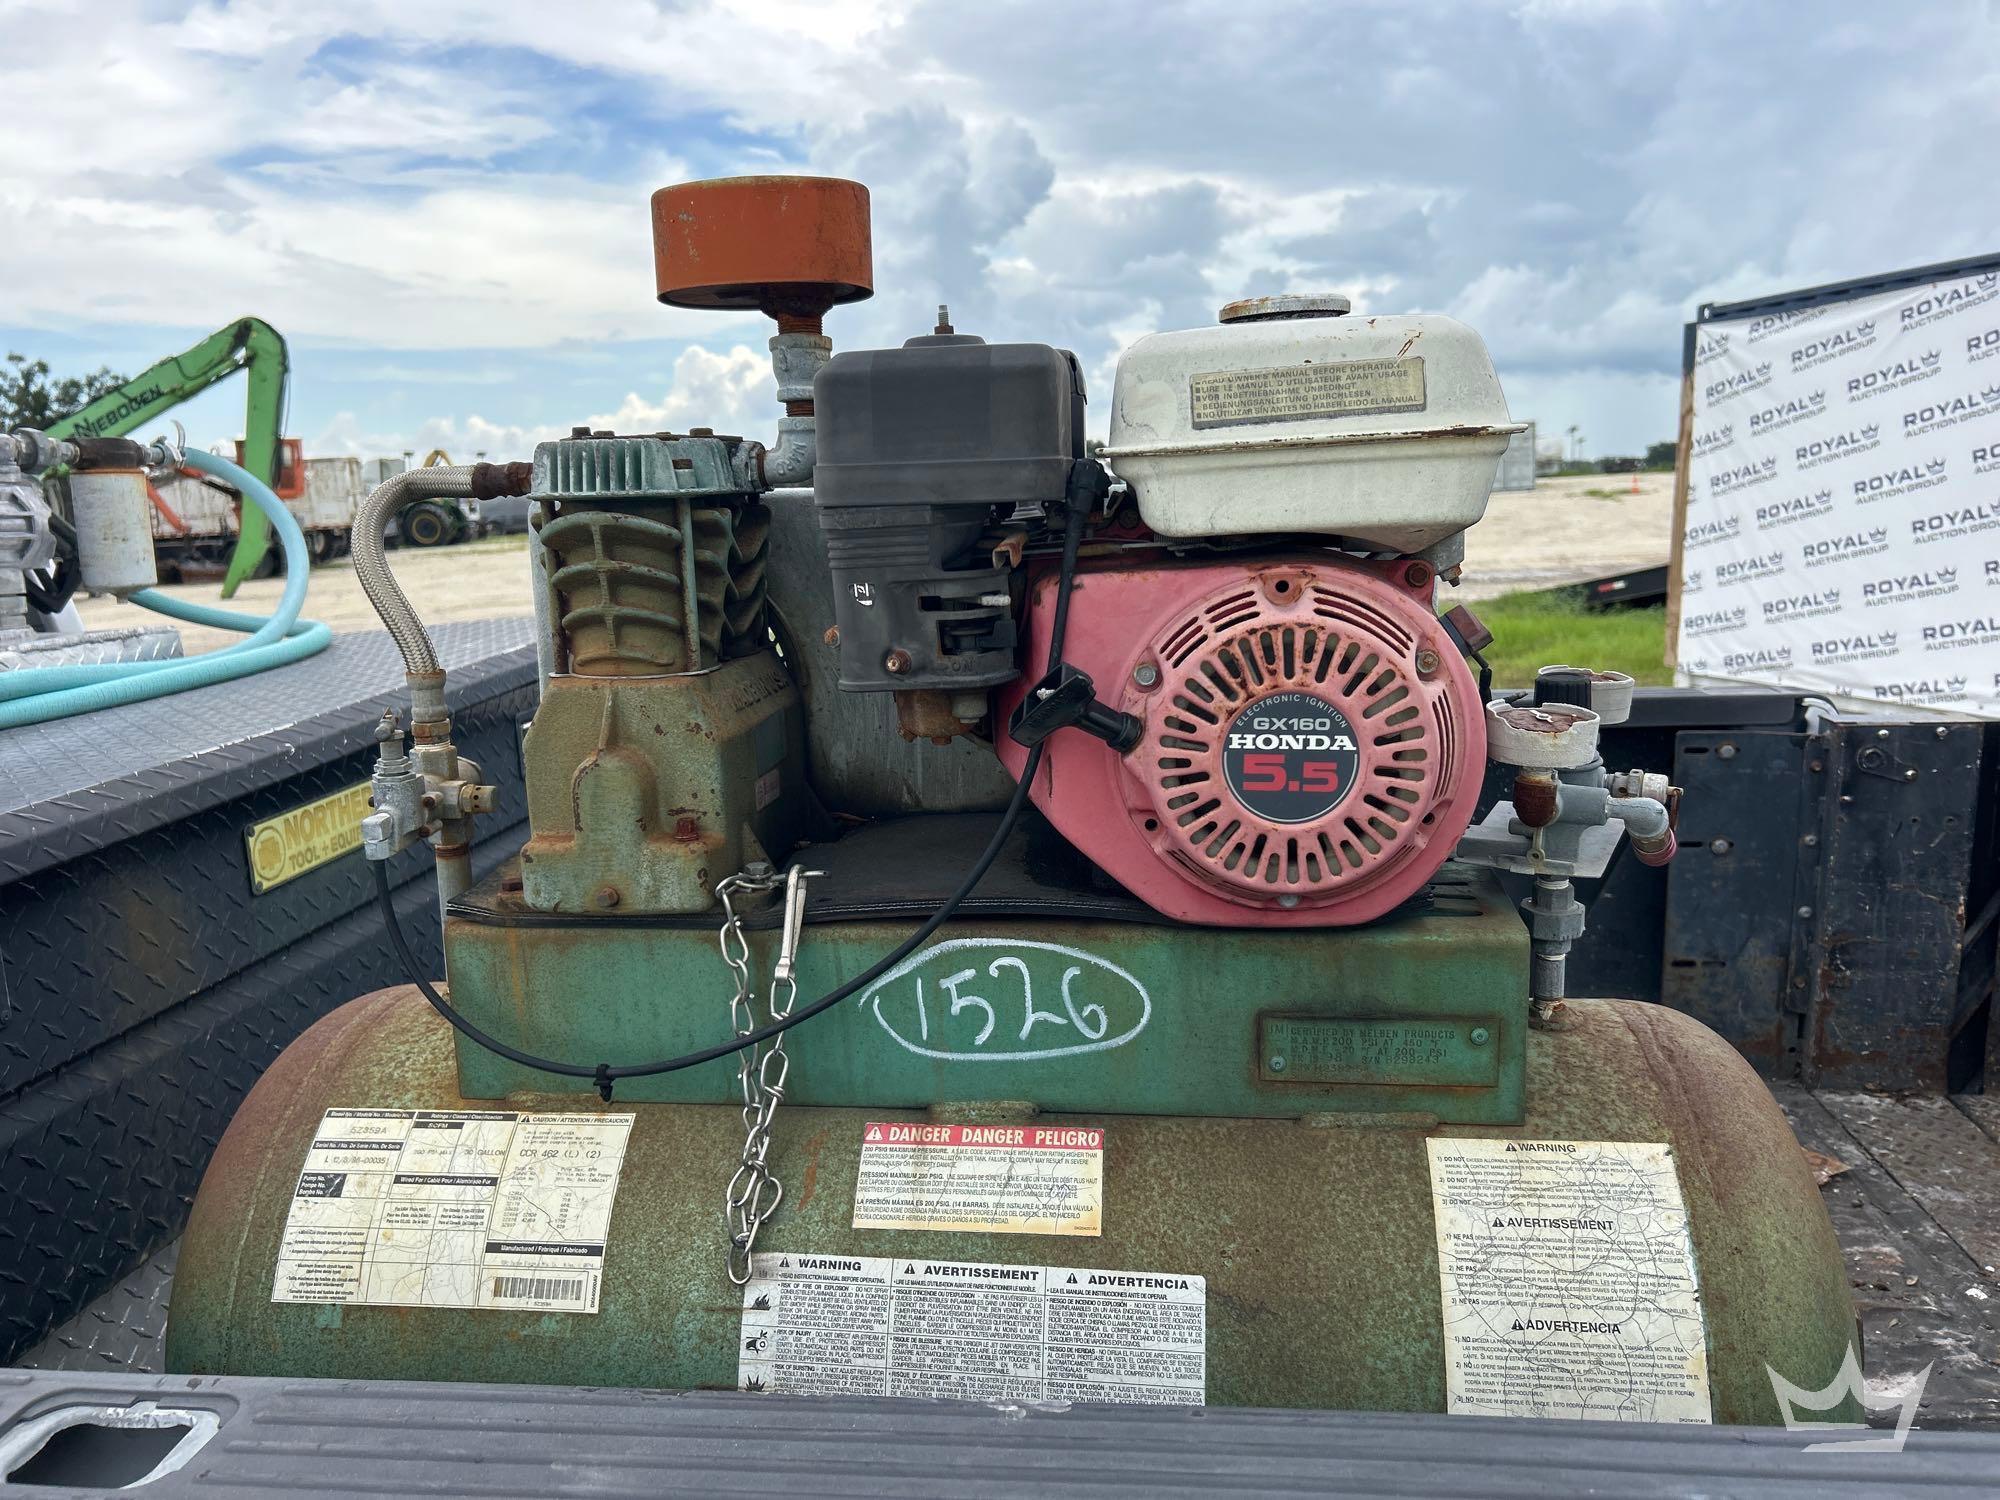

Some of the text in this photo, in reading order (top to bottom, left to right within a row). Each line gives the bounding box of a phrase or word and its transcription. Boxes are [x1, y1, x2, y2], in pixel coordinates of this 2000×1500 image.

[1901, 284, 1976, 321] ROYAL
[1791, 331, 1857, 363] ROYAL
[1201, 369, 1409, 394] LIRE LE MANUEL D'UTILISATEUR AVANT USAGE
[1272, 369, 1310, 379] MANUAL
[1313, 366, 1347, 376] BEFORE
[1848, 359, 1920, 394] ROYAL
[1201, 382, 1357, 402] VOR INBETRIEBNAHME UNBEDINGT
[1706, 369, 1756, 400] ROYAL
[1849, 366, 1941, 403] AUCTION GROUP
[1202, 411, 1215, 419] NO
[1216, 408, 1253, 418] UTILIZAR
[1270, 403, 1298, 413] ANTES
[1300, 402, 1312, 411] NO
[1313, 400, 1343, 410] HABER
[1382, 394, 1419, 405] MANUAL
[1203, 390, 1372, 411] BEDIENUNGSANLEITUNG DURCHLESEN
[1749, 397, 1808, 427] ROYAL
[1903, 394, 1980, 427] ROYAL
[1795, 432, 1861, 460] ROYAL
[1710, 462, 1761, 488] ROYAL
[1854, 466, 1926, 495] ROYAL
[1855, 475, 1948, 505] AUCTION GROUP
[1756, 496, 1815, 521] ROYAL
[1912, 506, 1990, 533] ROYAL
[1803, 533, 1869, 557] ROYAL
[1716, 558, 1768, 577] ROYAL
[1863, 573, 1937, 597] ROYAL
[1865, 585, 1960, 608] AUCTION GROUP
[1763, 593, 1823, 615] ROYAL
[1684, 611, 1732, 629] ROYAL
[1923, 617, 2000, 640] ROYAL
[1812, 634, 1879, 656] ROYAL
[1725, 650, 1777, 667] ROYAL
[1875, 679, 1945, 698] ROYAL
[1236, 694, 1348, 729] ELECTRONIC IGNITION
[1253, 717, 1331, 731] GX160
[1228, 733, 1357, 751] HONDA
[1242, 753, 1339, 793] 5.5
[288, 845, 321, 872] TOOL
[916, 956, 1108, 1046] 1526
[1404, 1029, 1456, 1039] PRODUCTS
[532, 1116, 630, 1125] CAUTION ATTENTION PRECAUCION
[889, 1126, 1100, 1147] DANGER DANGER PELIGRO
[519, 1149, 538, 1158] CCR
[541, 1149, 559, 1158] 462
[585, 1150, 602, 1159] (2)
[1517, 1143, 1577, 1154] WARNING
[1506, 1216, 1614, 1231] AVERTISSEMENT
[798, 1258, 862, 1271] WARNING
[923, 1265, 1039, 1281] AVERTISSEMENT
[1087, 1274, 1189, 1289] ADVERTENCIA
[1525, 1319, 1622, 1335] ADVERTENCIA
